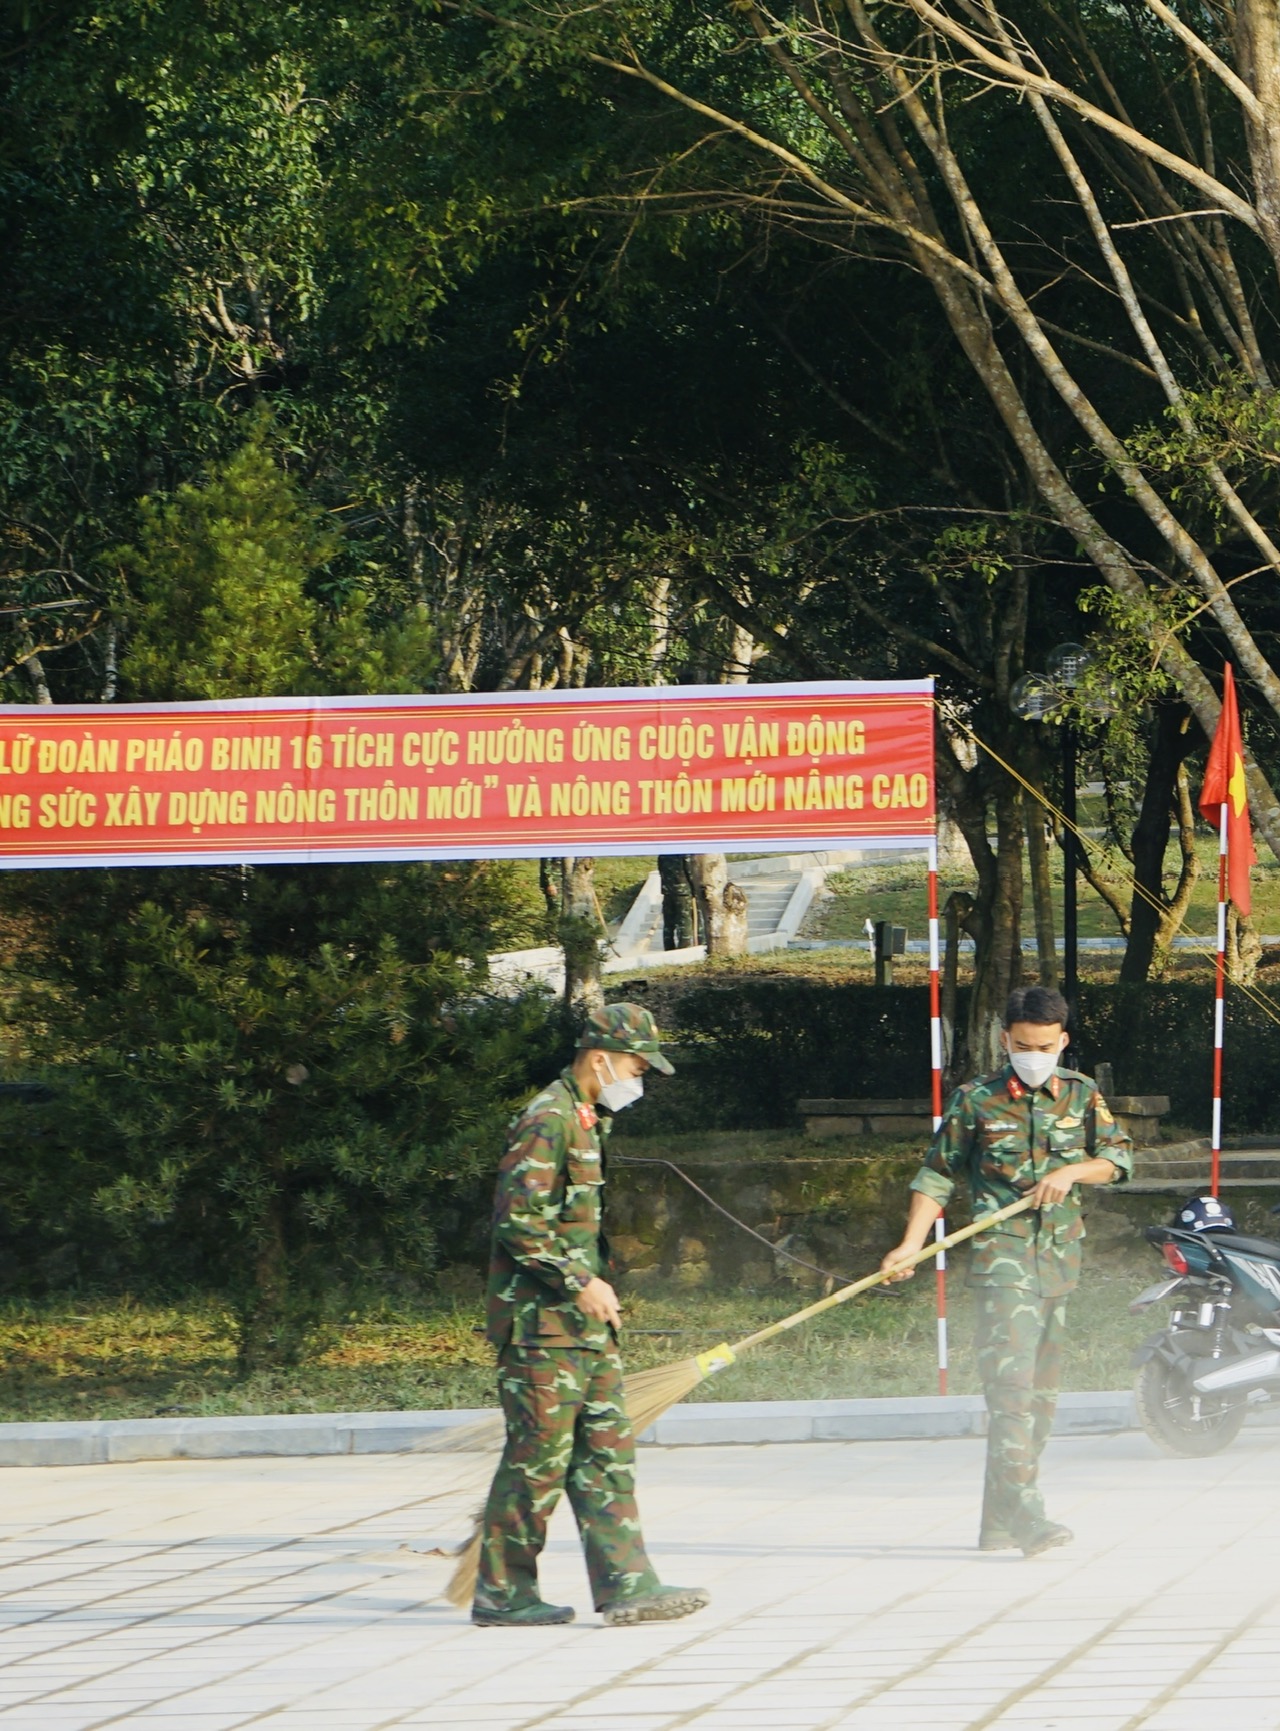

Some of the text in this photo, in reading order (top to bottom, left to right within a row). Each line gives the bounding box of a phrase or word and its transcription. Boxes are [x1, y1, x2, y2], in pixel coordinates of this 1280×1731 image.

[0, 715, 866, 775] LỮ ĐOÀN PHÁO BINH 16 TÍCH CỰC HƯỞNG ỨNG CUỘC VẬN ĐỘNG
[38, 786, 97, 828] SỨC
[104, 785, 162, 827] XÂY
[168, 787, 248, 834] DỰNG
[255, 782, 336, 824] NÔNG
[344, 780, 420, 822] THÔN
[506, 776, 543, 818] VÀ
[550, 774, 631, 817] NÔNG
[638, 771, 714, 814] THÔN
[720, 770, 776, 813] MỚI
[783, 769, 864, 811] NÂNG
[871, 772, 929, 809] CAO
